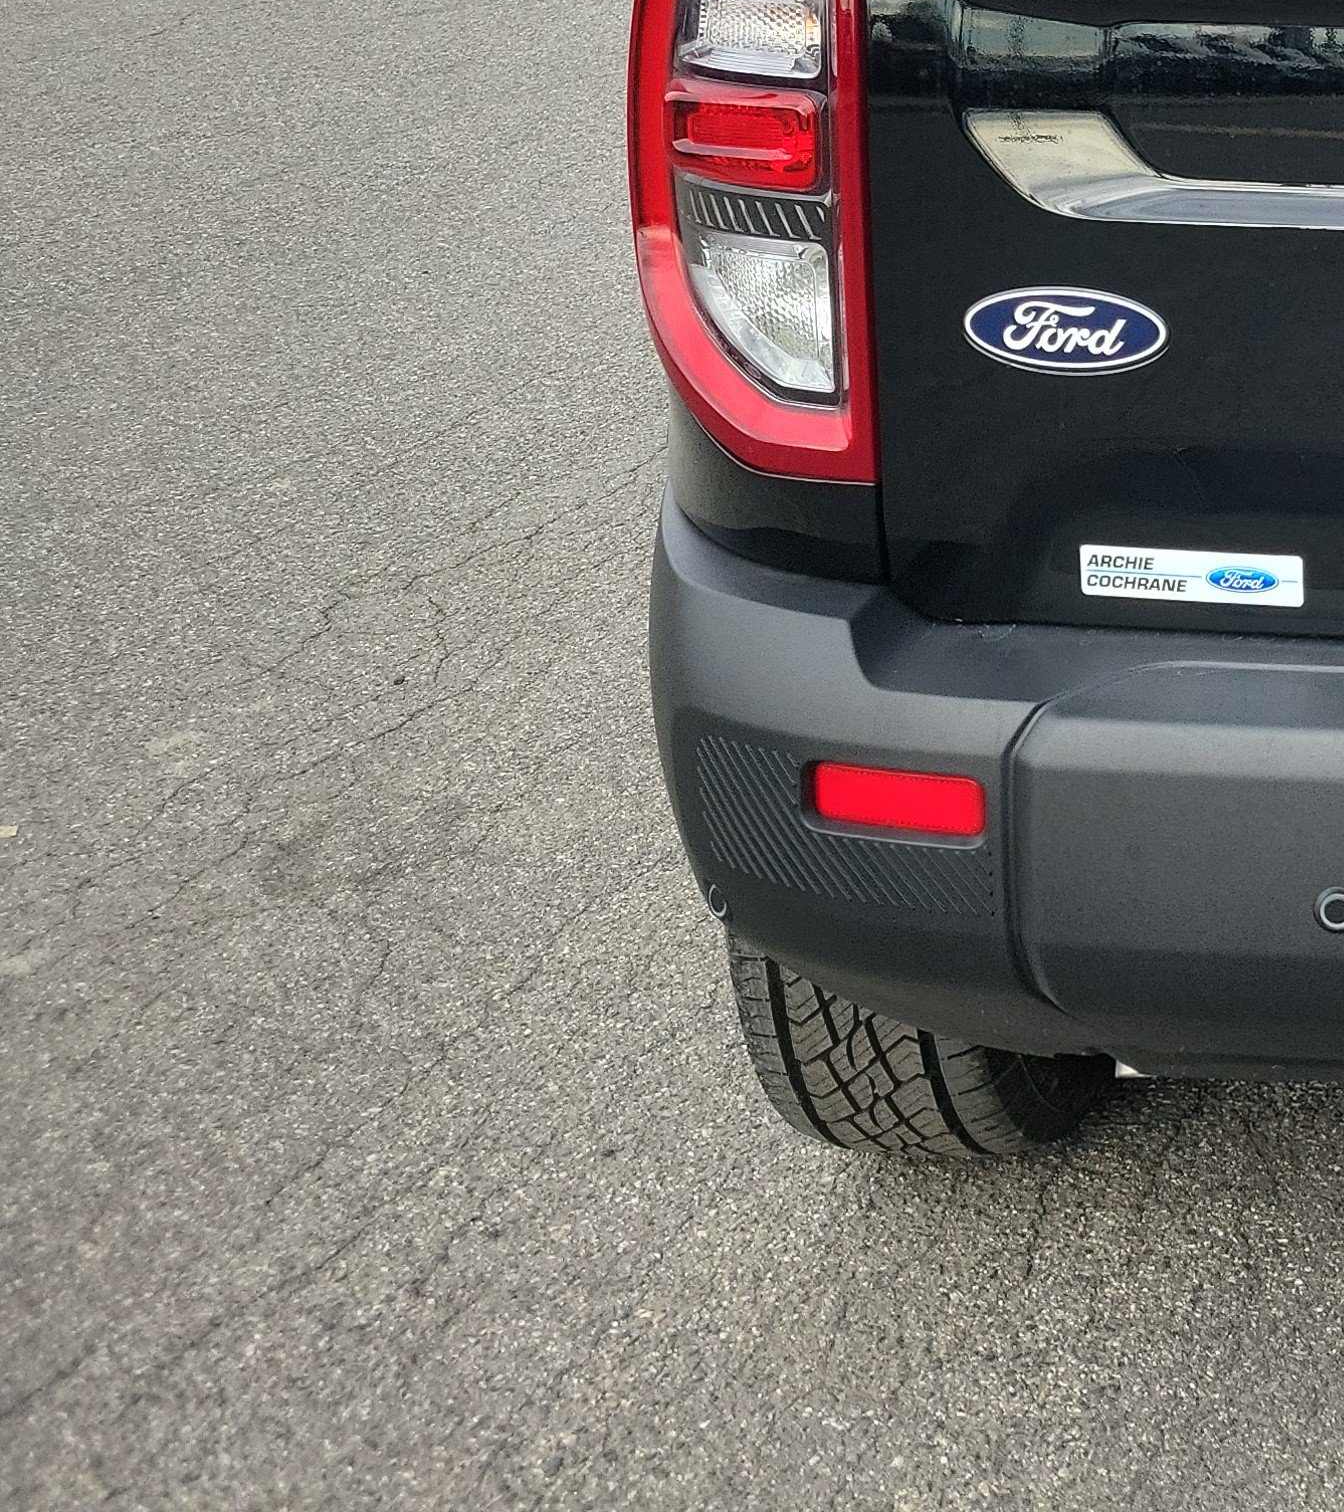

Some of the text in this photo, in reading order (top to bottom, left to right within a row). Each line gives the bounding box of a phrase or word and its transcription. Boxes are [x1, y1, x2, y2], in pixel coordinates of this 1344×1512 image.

[1003, 300, 1127, 356] Ford
[1087, 554, 1155, 570] ARCHIE
[1087, 574, 1188, 593] COCHRANE
[1220, 570, 1265, 590] Ford
